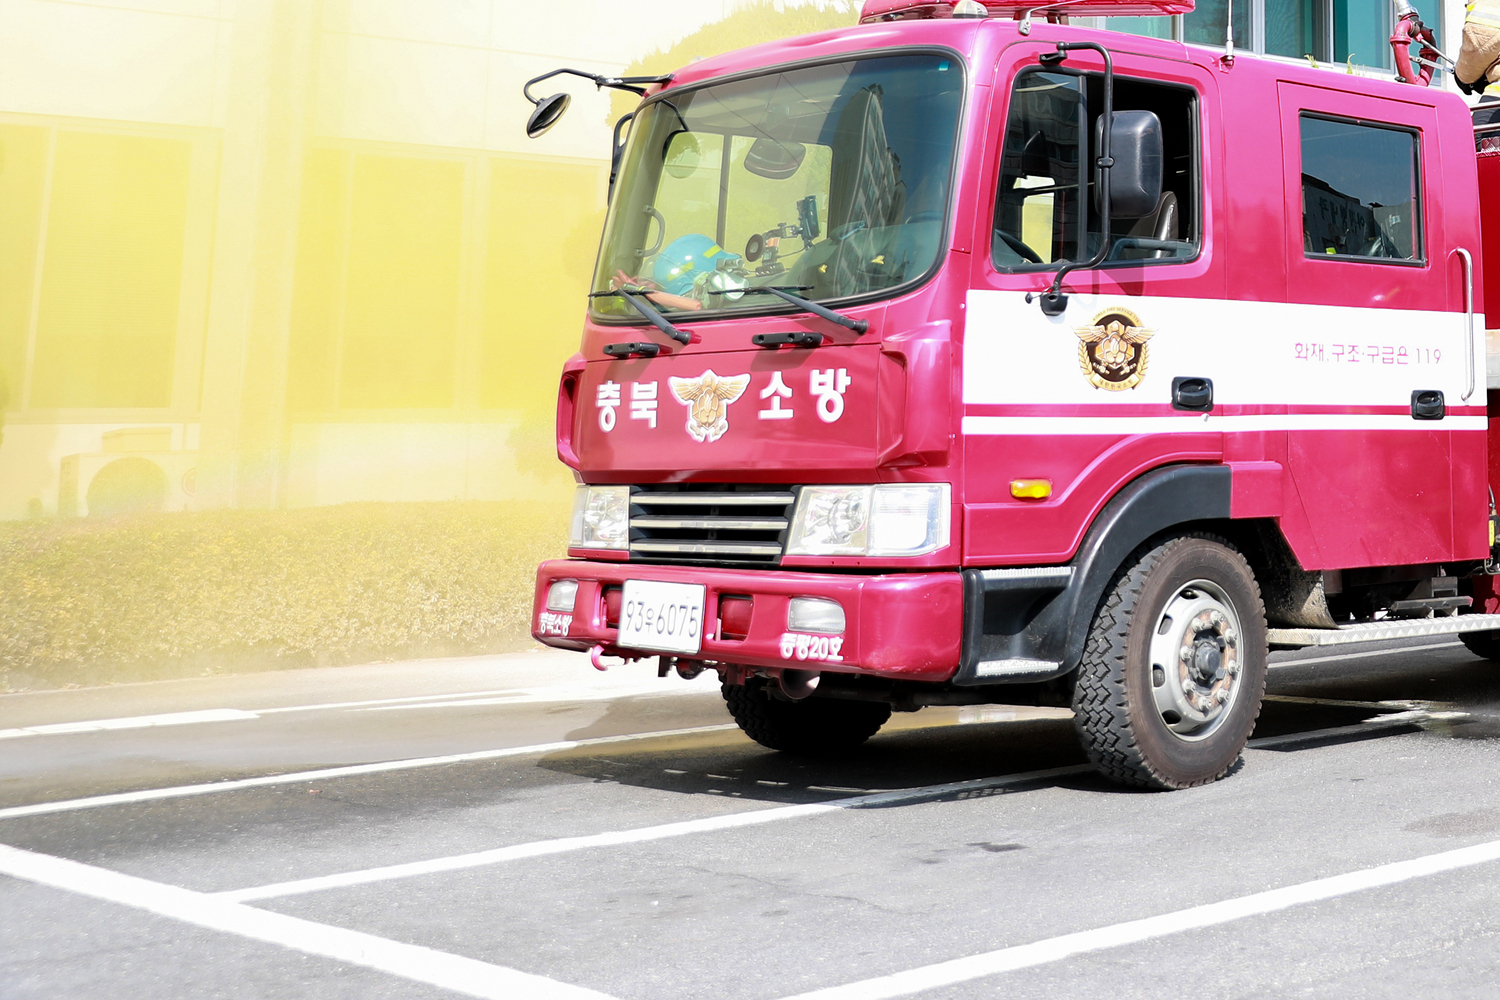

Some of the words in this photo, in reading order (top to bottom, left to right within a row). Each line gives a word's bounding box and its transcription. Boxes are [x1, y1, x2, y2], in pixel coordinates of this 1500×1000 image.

[1416, 348, 1441, 365] 119
[597, 380, 658, 432] 충북
[758, 368, 852, 423] 소방
[538, 612, 573, 637] 충북소방
[625, 600, 700, 638] 93우6075
[780, 632, 845, 662] 증평20호
